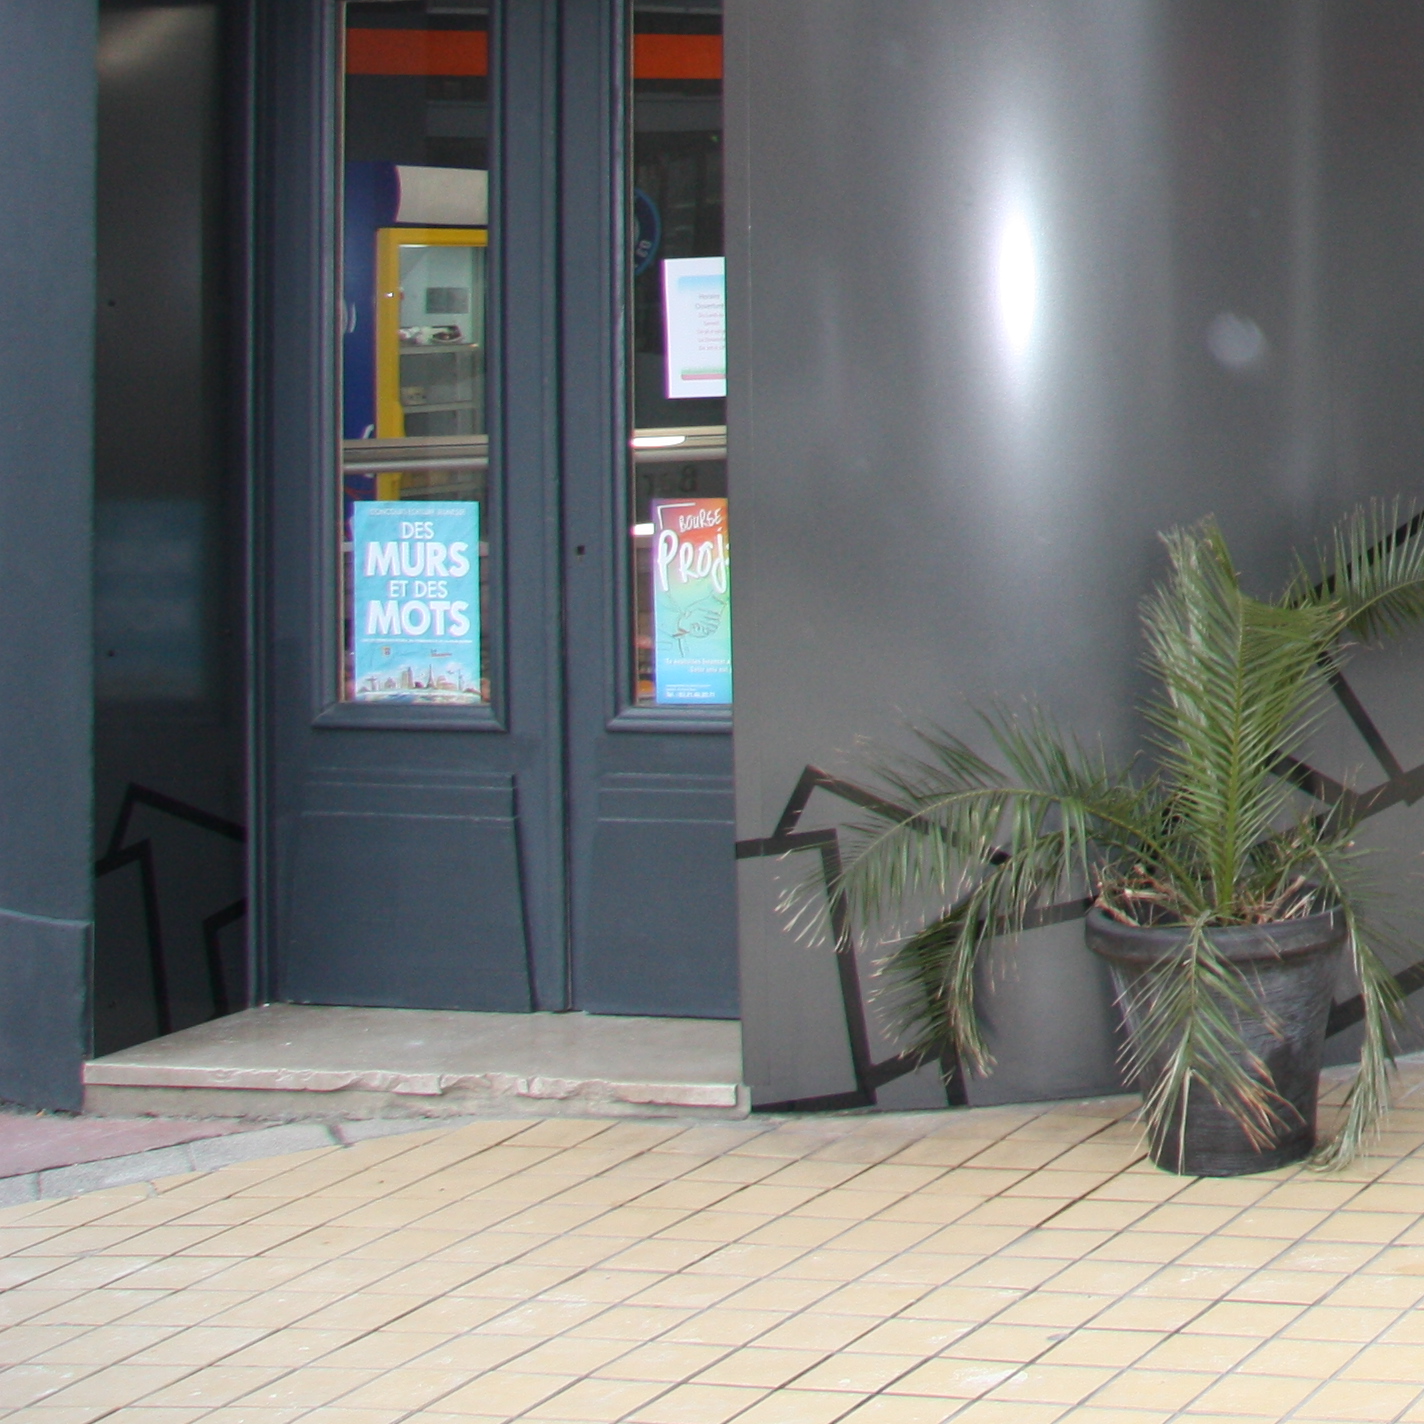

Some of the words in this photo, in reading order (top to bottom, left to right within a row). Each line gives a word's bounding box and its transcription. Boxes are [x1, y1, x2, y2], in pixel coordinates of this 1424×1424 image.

[400, 521, 435, 540] DES
[679, 507, 724, 533] BOURSE
[365, 541, 471, 577] MURS
[389, 580, 409, 598] ET
[414, 580, 449, 599] DES
[367, 599, 471, 637] MOTS
